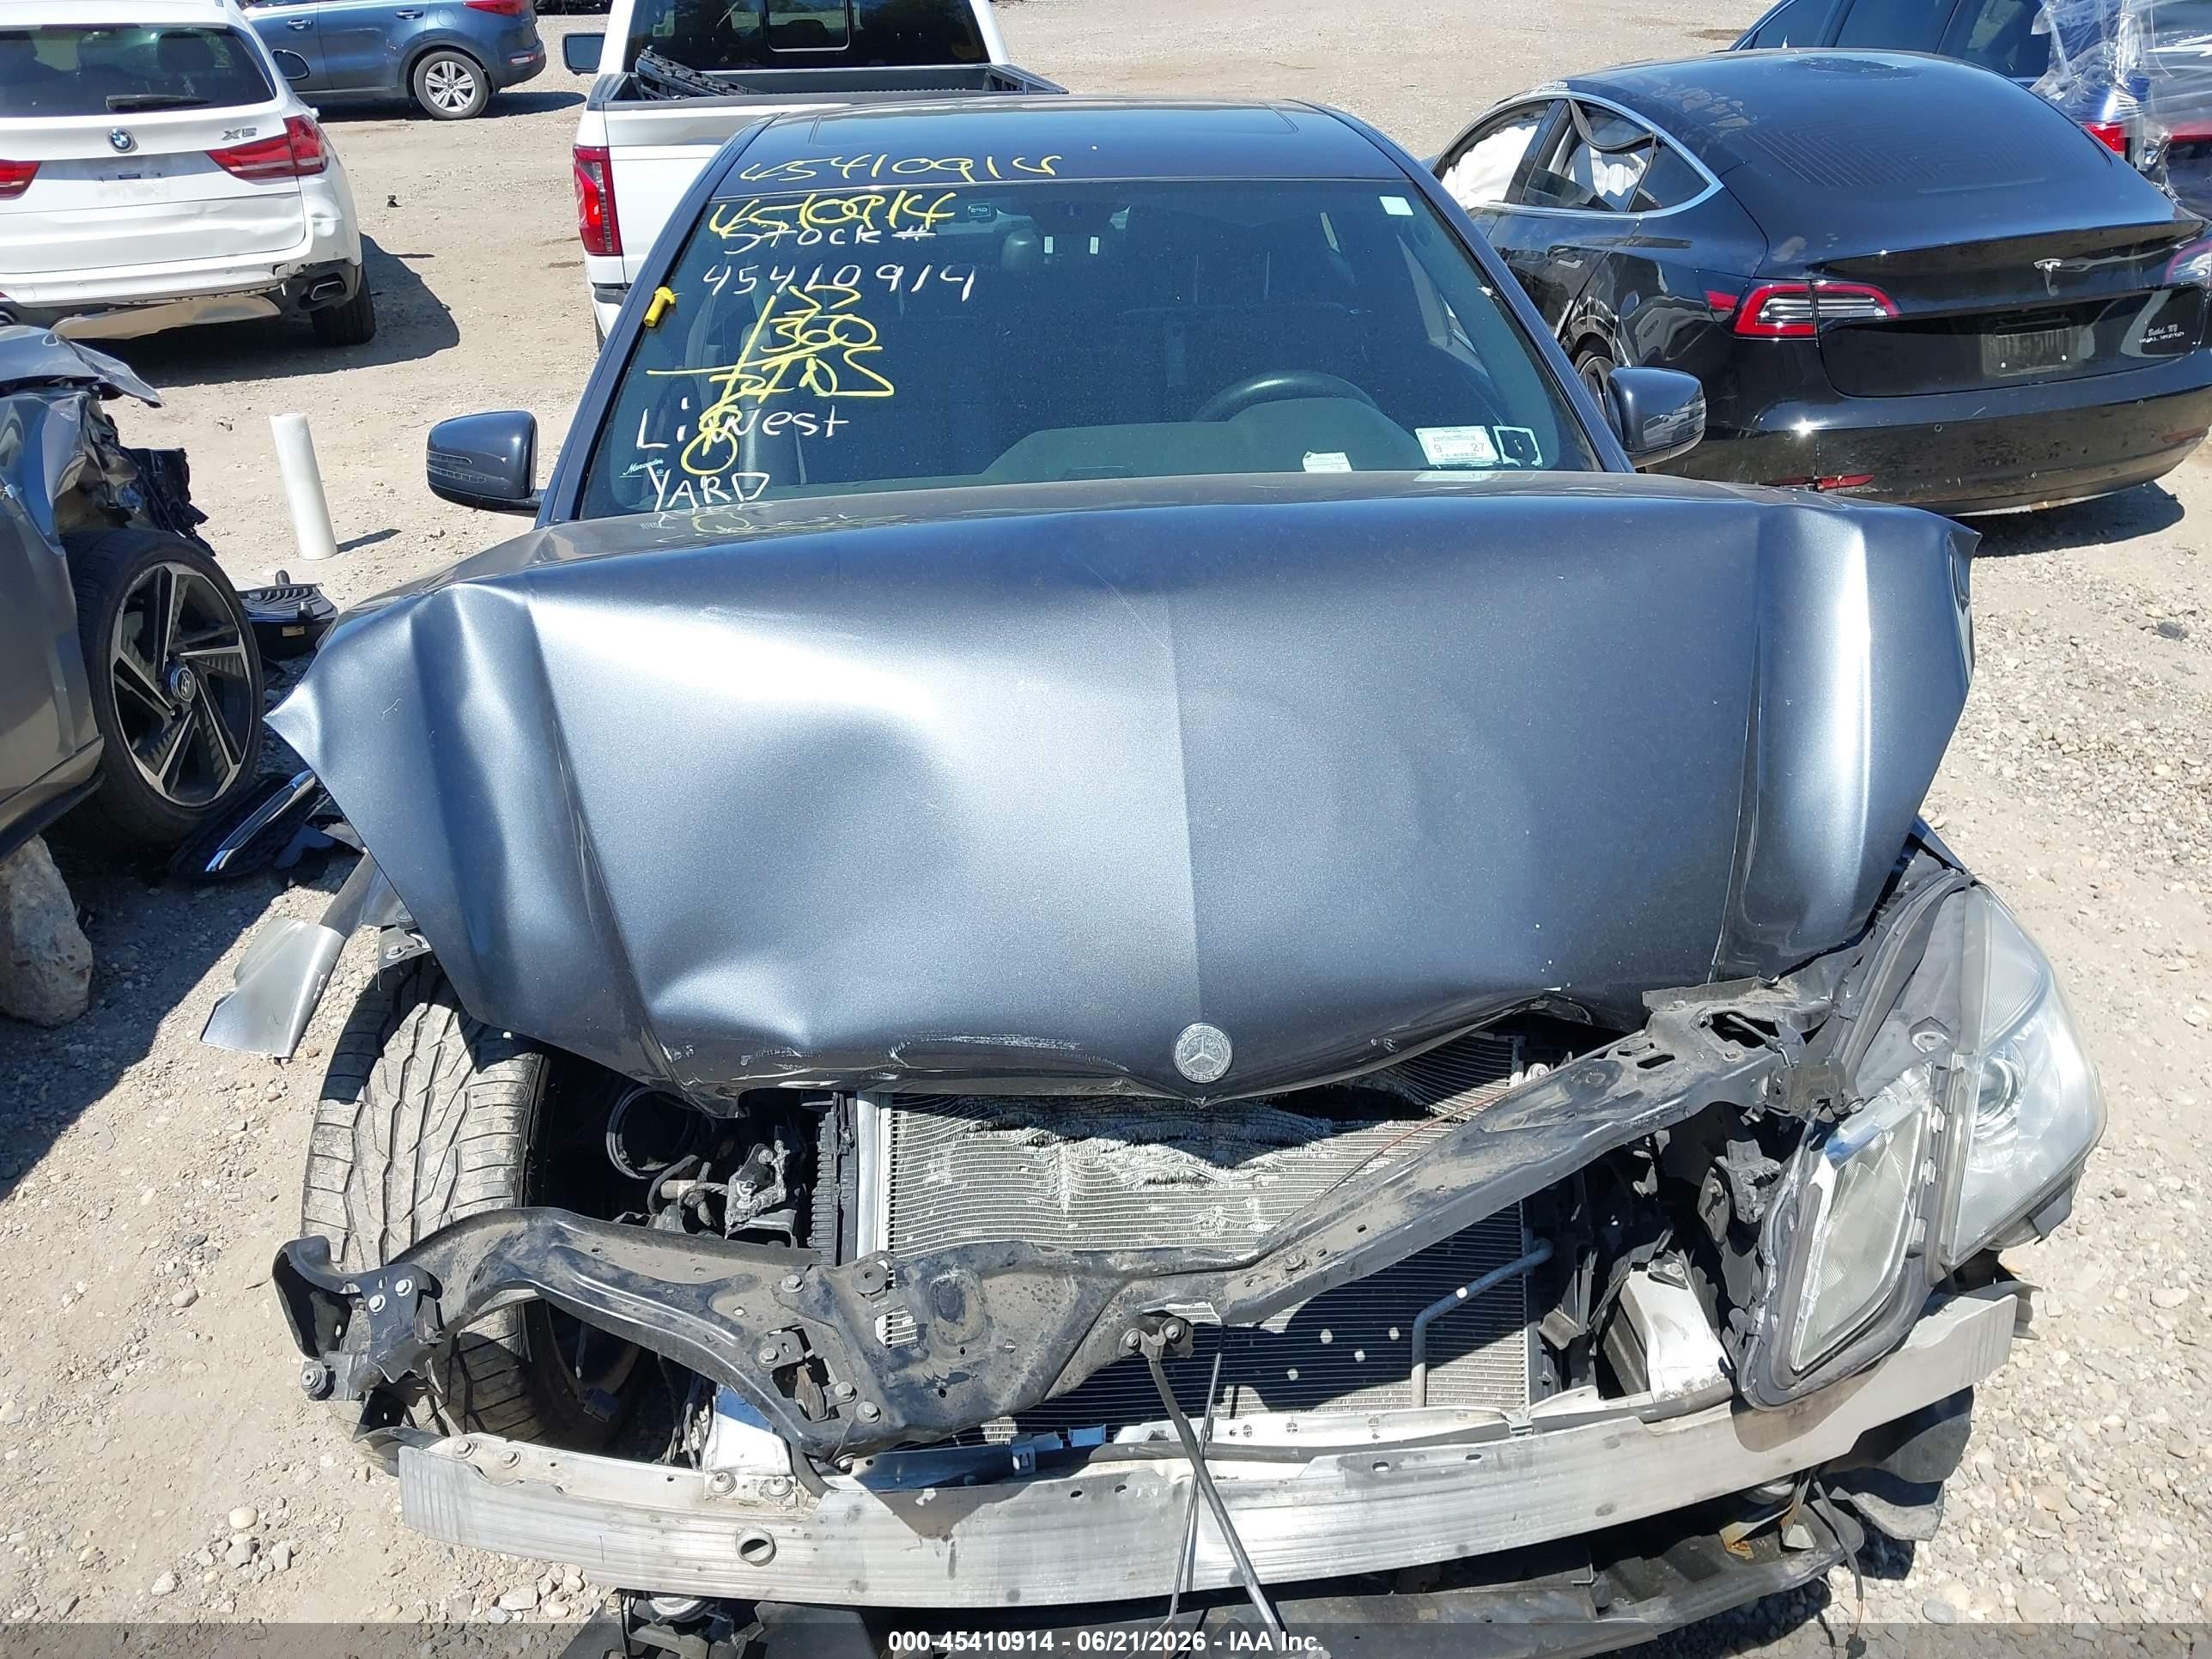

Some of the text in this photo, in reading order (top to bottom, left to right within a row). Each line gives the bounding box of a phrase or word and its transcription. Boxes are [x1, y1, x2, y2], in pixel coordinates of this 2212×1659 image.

[221, 127, 258, 141] X5
[891, 224, 938, 241] #
[702, 264, 976, 302] 45410914
[647, 466, 770, 513] YARD
